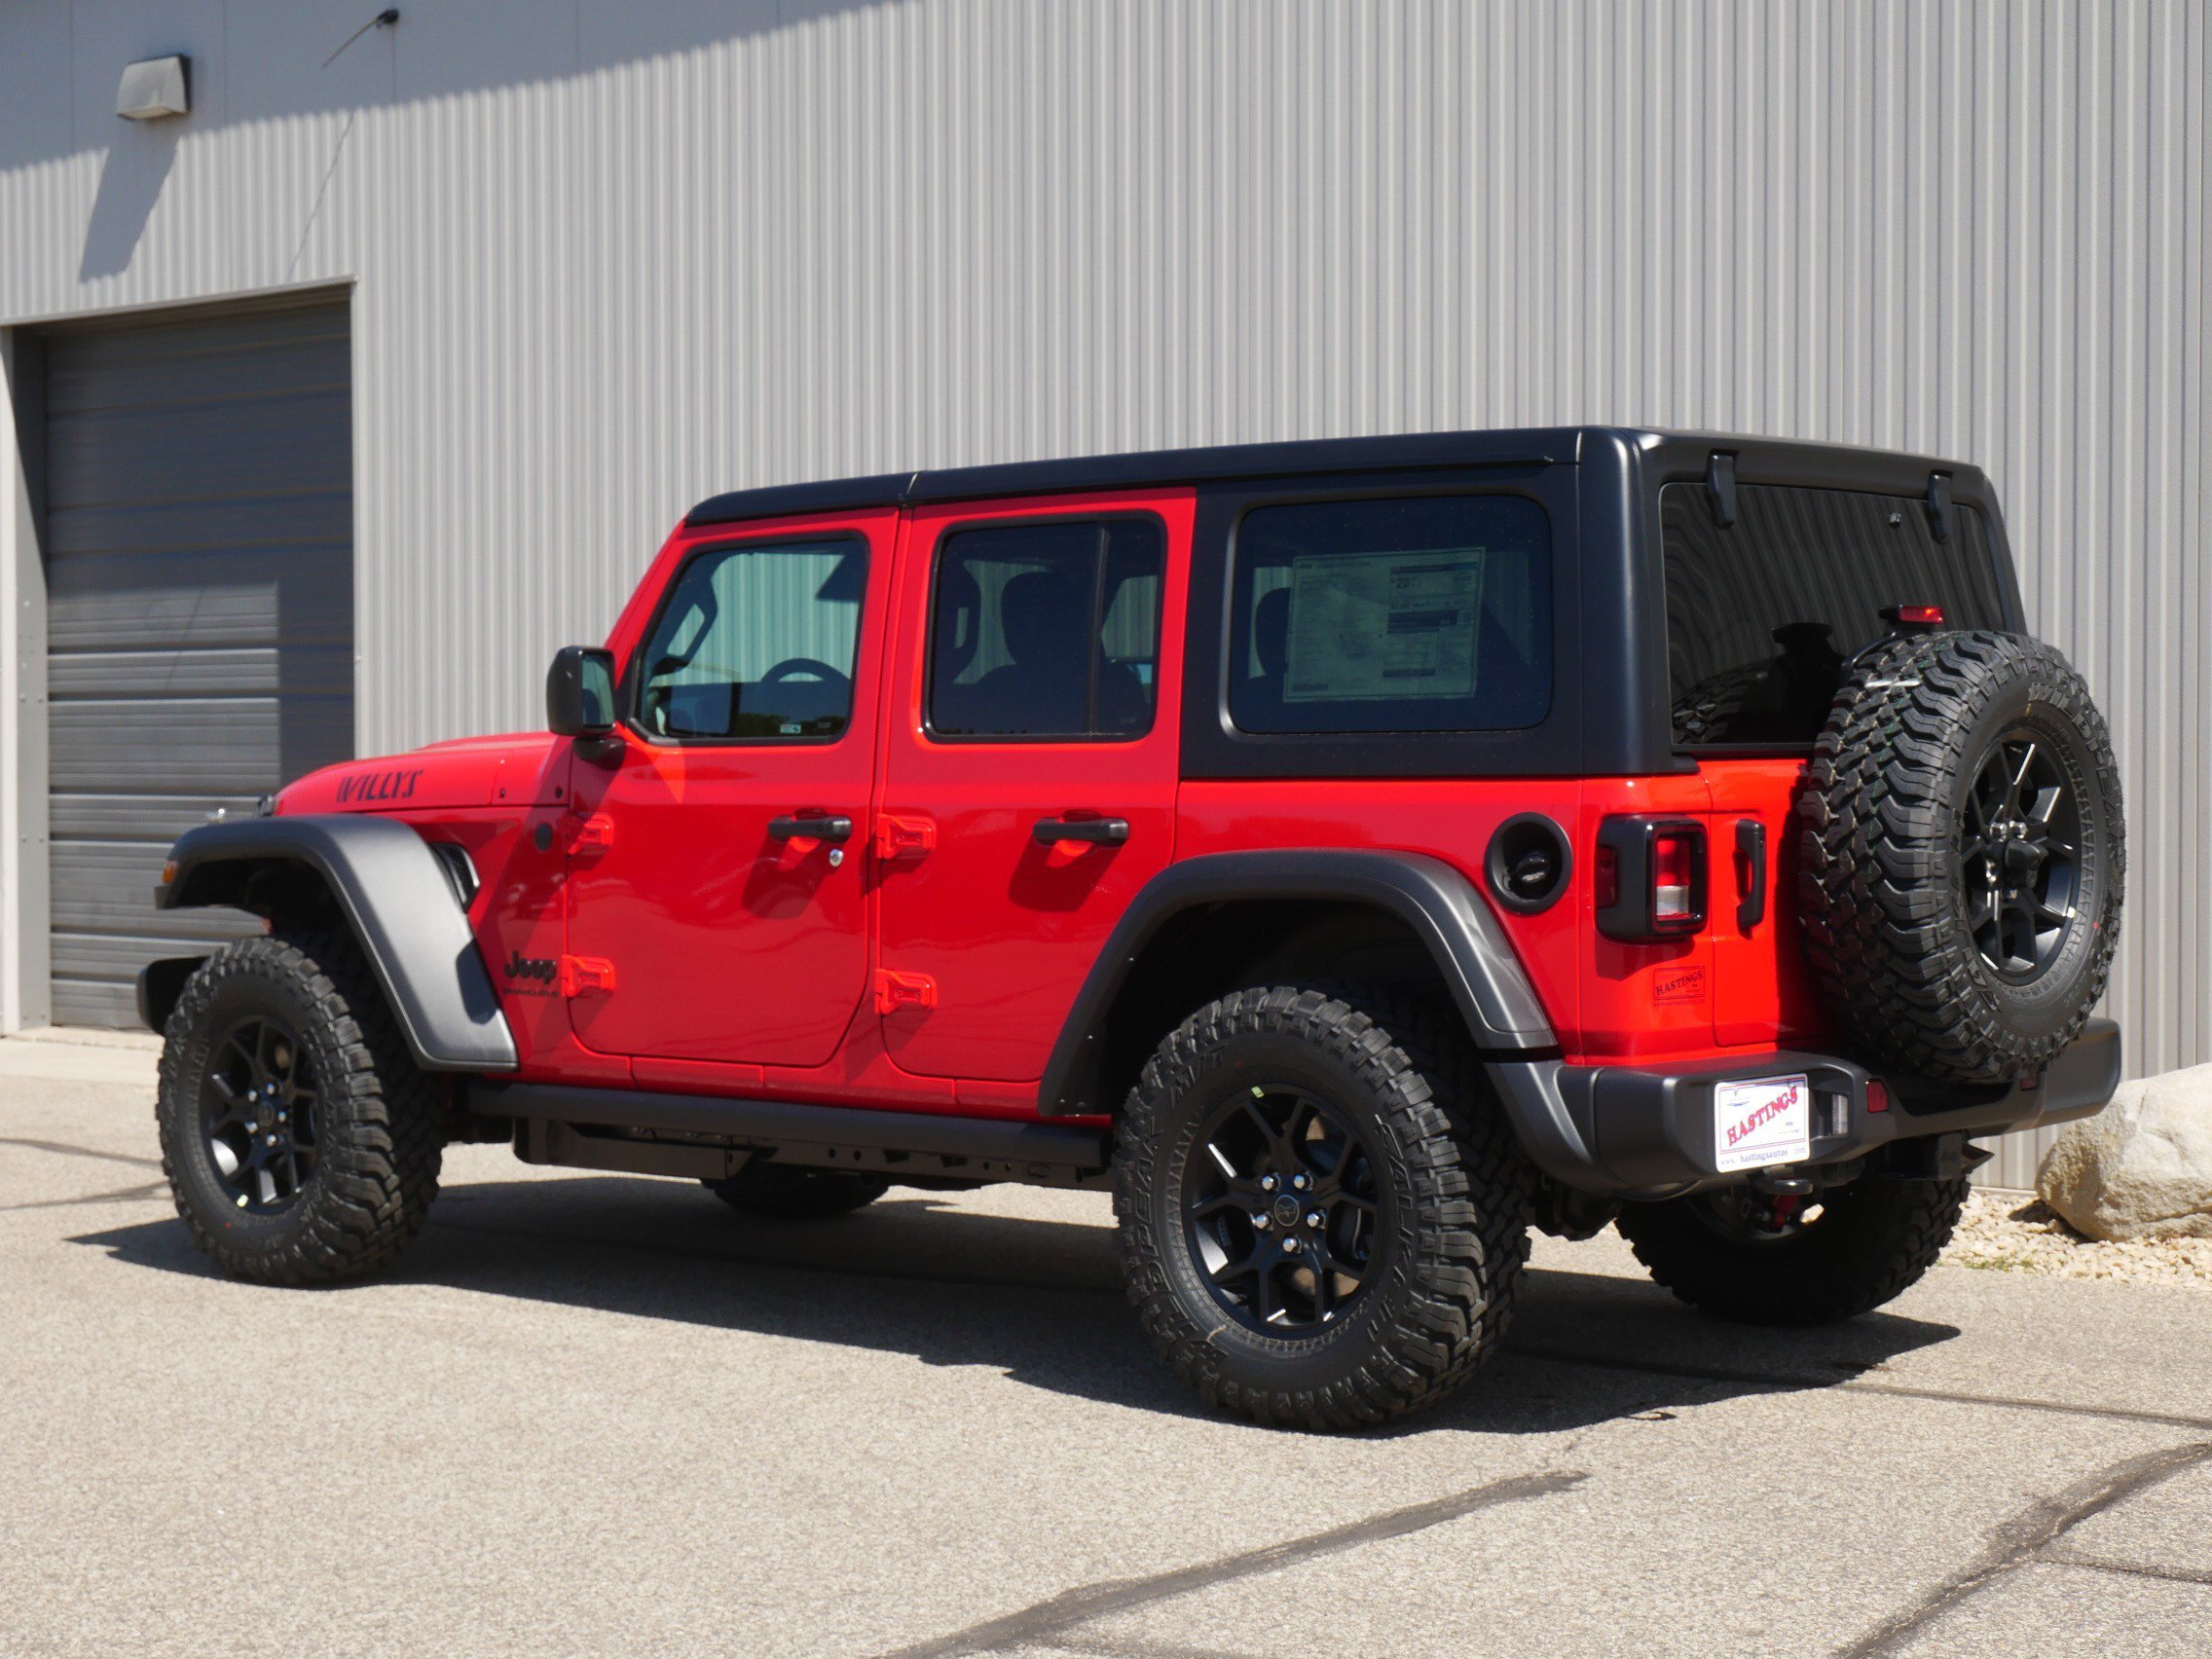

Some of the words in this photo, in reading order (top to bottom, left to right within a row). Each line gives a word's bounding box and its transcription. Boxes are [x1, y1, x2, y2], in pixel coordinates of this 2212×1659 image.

[337, 769, 424, 803] WILLYS
[503, 950, 557, 985] Jeep
[1656, 970, 1704, 997] HASTINGS
[1726, 1086, 1798, 1147] HASTINGS
